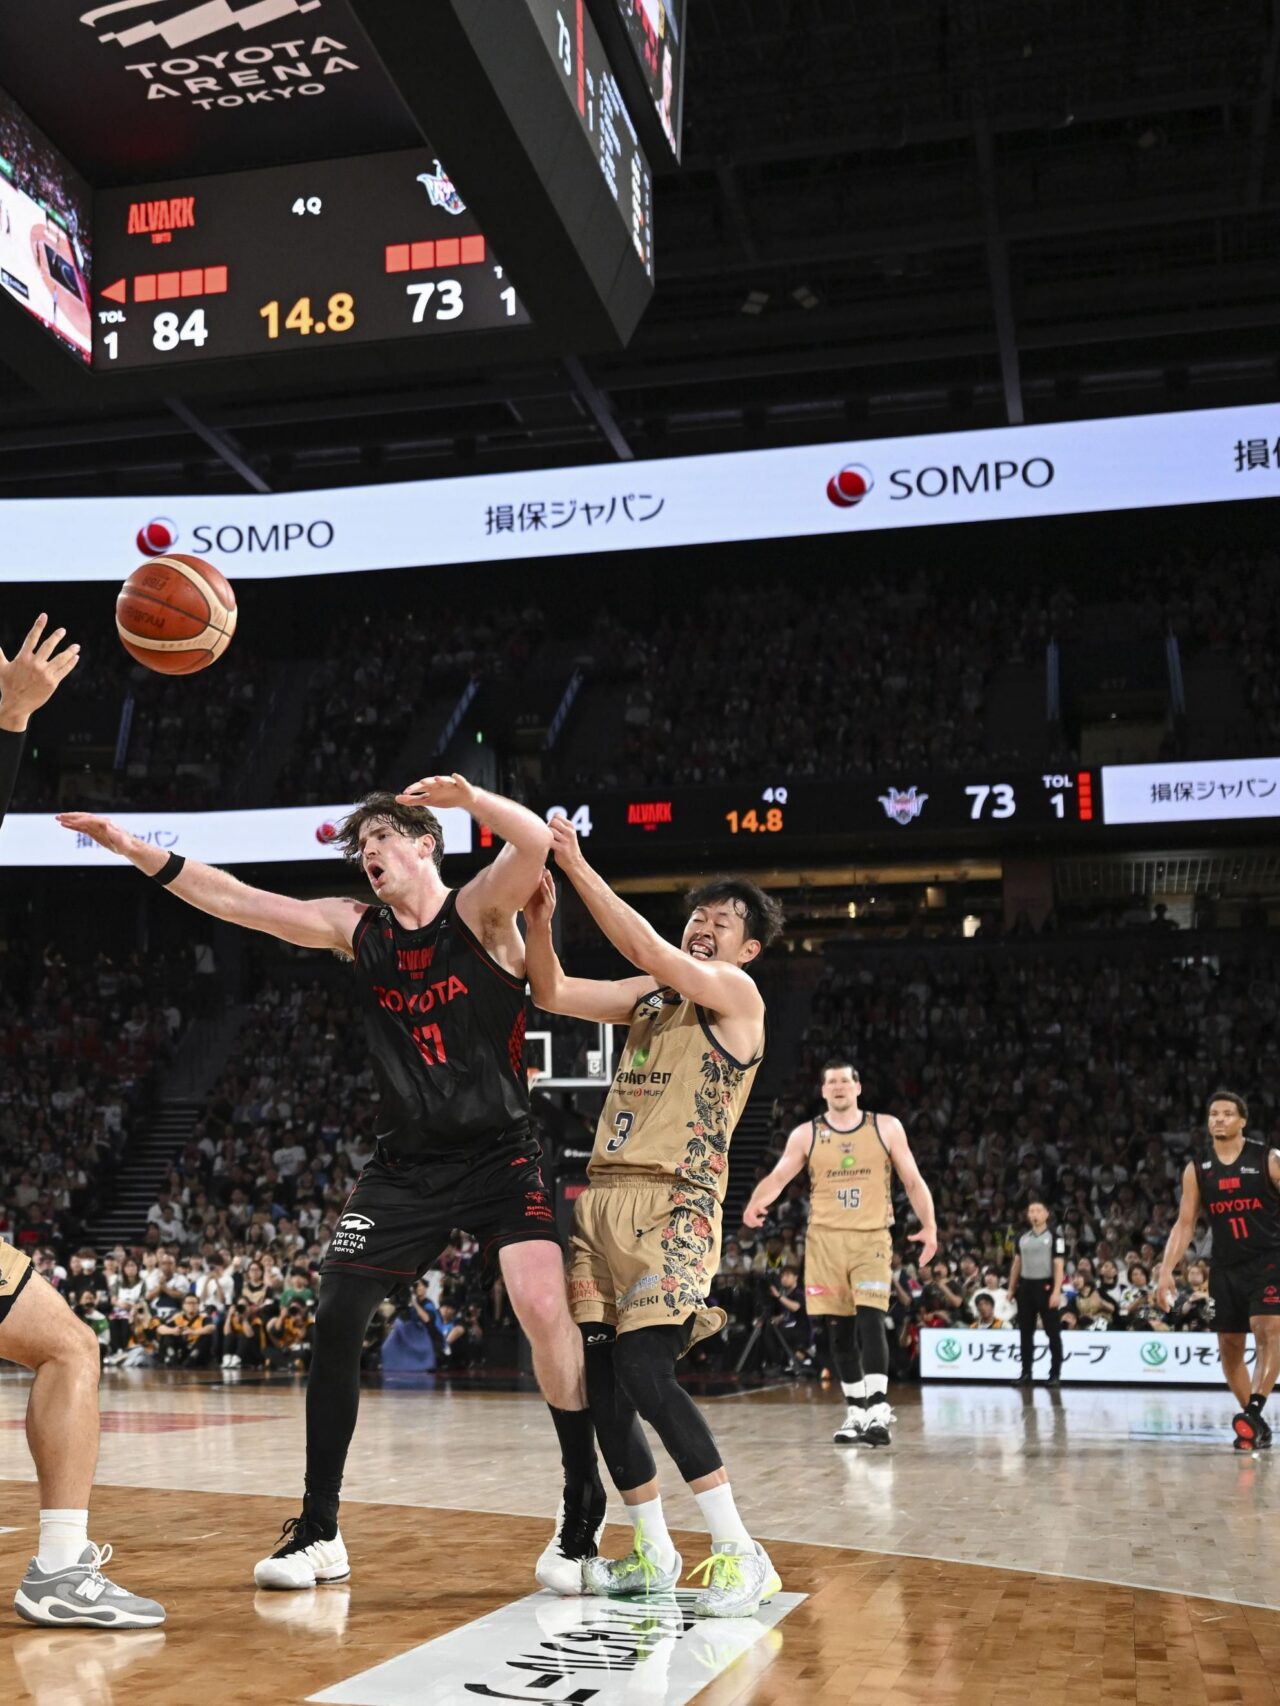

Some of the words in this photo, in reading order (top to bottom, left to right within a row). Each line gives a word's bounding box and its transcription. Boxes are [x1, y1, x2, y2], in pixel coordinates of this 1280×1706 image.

[124, 35, 349, 80] TOYOTA
[146, 56, 361, 101] ARENA
[191, 82, 327, 111] TOKYO
[127, 196, 196, 235] ALVARK
[291, 196, 323, 216] 4Q
[406, 279, 465, 324] 73
[500, 286, 517, 317] 1
[98, 310, 127, 325] TOL
[259, 292, 356, 339] 14.8
[152, 308, 209, 351] 84
[103, 331, 119, 360] 1
[889, 456, 1055, 501] SOMPO
[485, 493, 665, 536] 損保ジャパン
[191, 520, 335, 554] SOMPO
[762, 786, 788, 805] 4Q
[1043, 775, 1073, 789] TOL
[1150, 778, 1277, 804] 損保ジャパン
[627, 802, 672, 824] ALVARK
[964, 783, 1017, 820] 73
[1050, 793, 1065, 818] 1
[725, 808, 784, 834] 14.8
[606, 1111, 635, 1153] 3
[837, 1187, 861, 1210] 45
[1209, 1198, 1263, 1215] TOYOTA
[335, 1231, 367, 1243] TOYOTA
[1228, 1217, 1249, 1239] 11
[331, 1239, 365, 1250] ARENA
[334, 1246, 355, 1254] TOKYO
